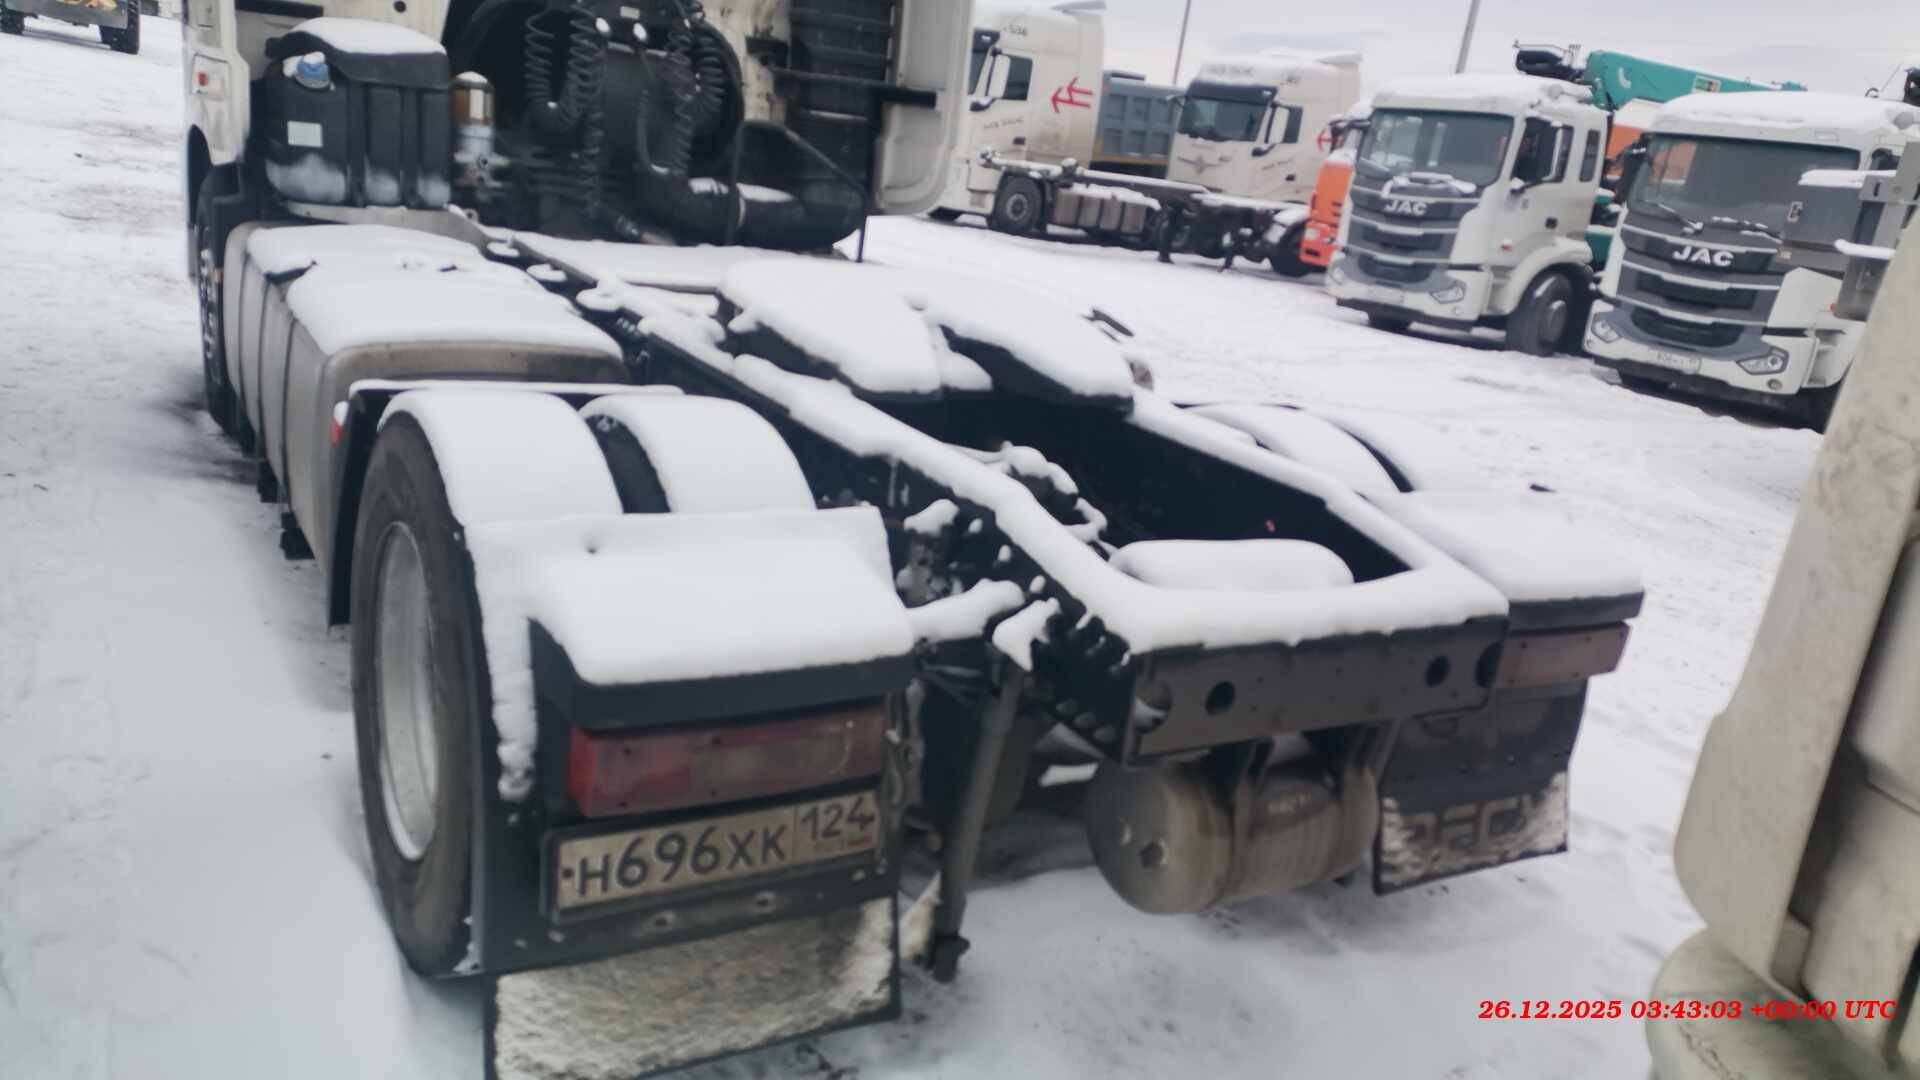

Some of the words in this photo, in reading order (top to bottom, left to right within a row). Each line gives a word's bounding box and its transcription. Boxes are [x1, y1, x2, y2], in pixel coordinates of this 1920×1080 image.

[1384, 199, 1427, 216] JAC
[1672, 246, 1734, 267] JAC
[578, 825, 787, 897] Н696ХК
[801, 796, 876, 840] 124
